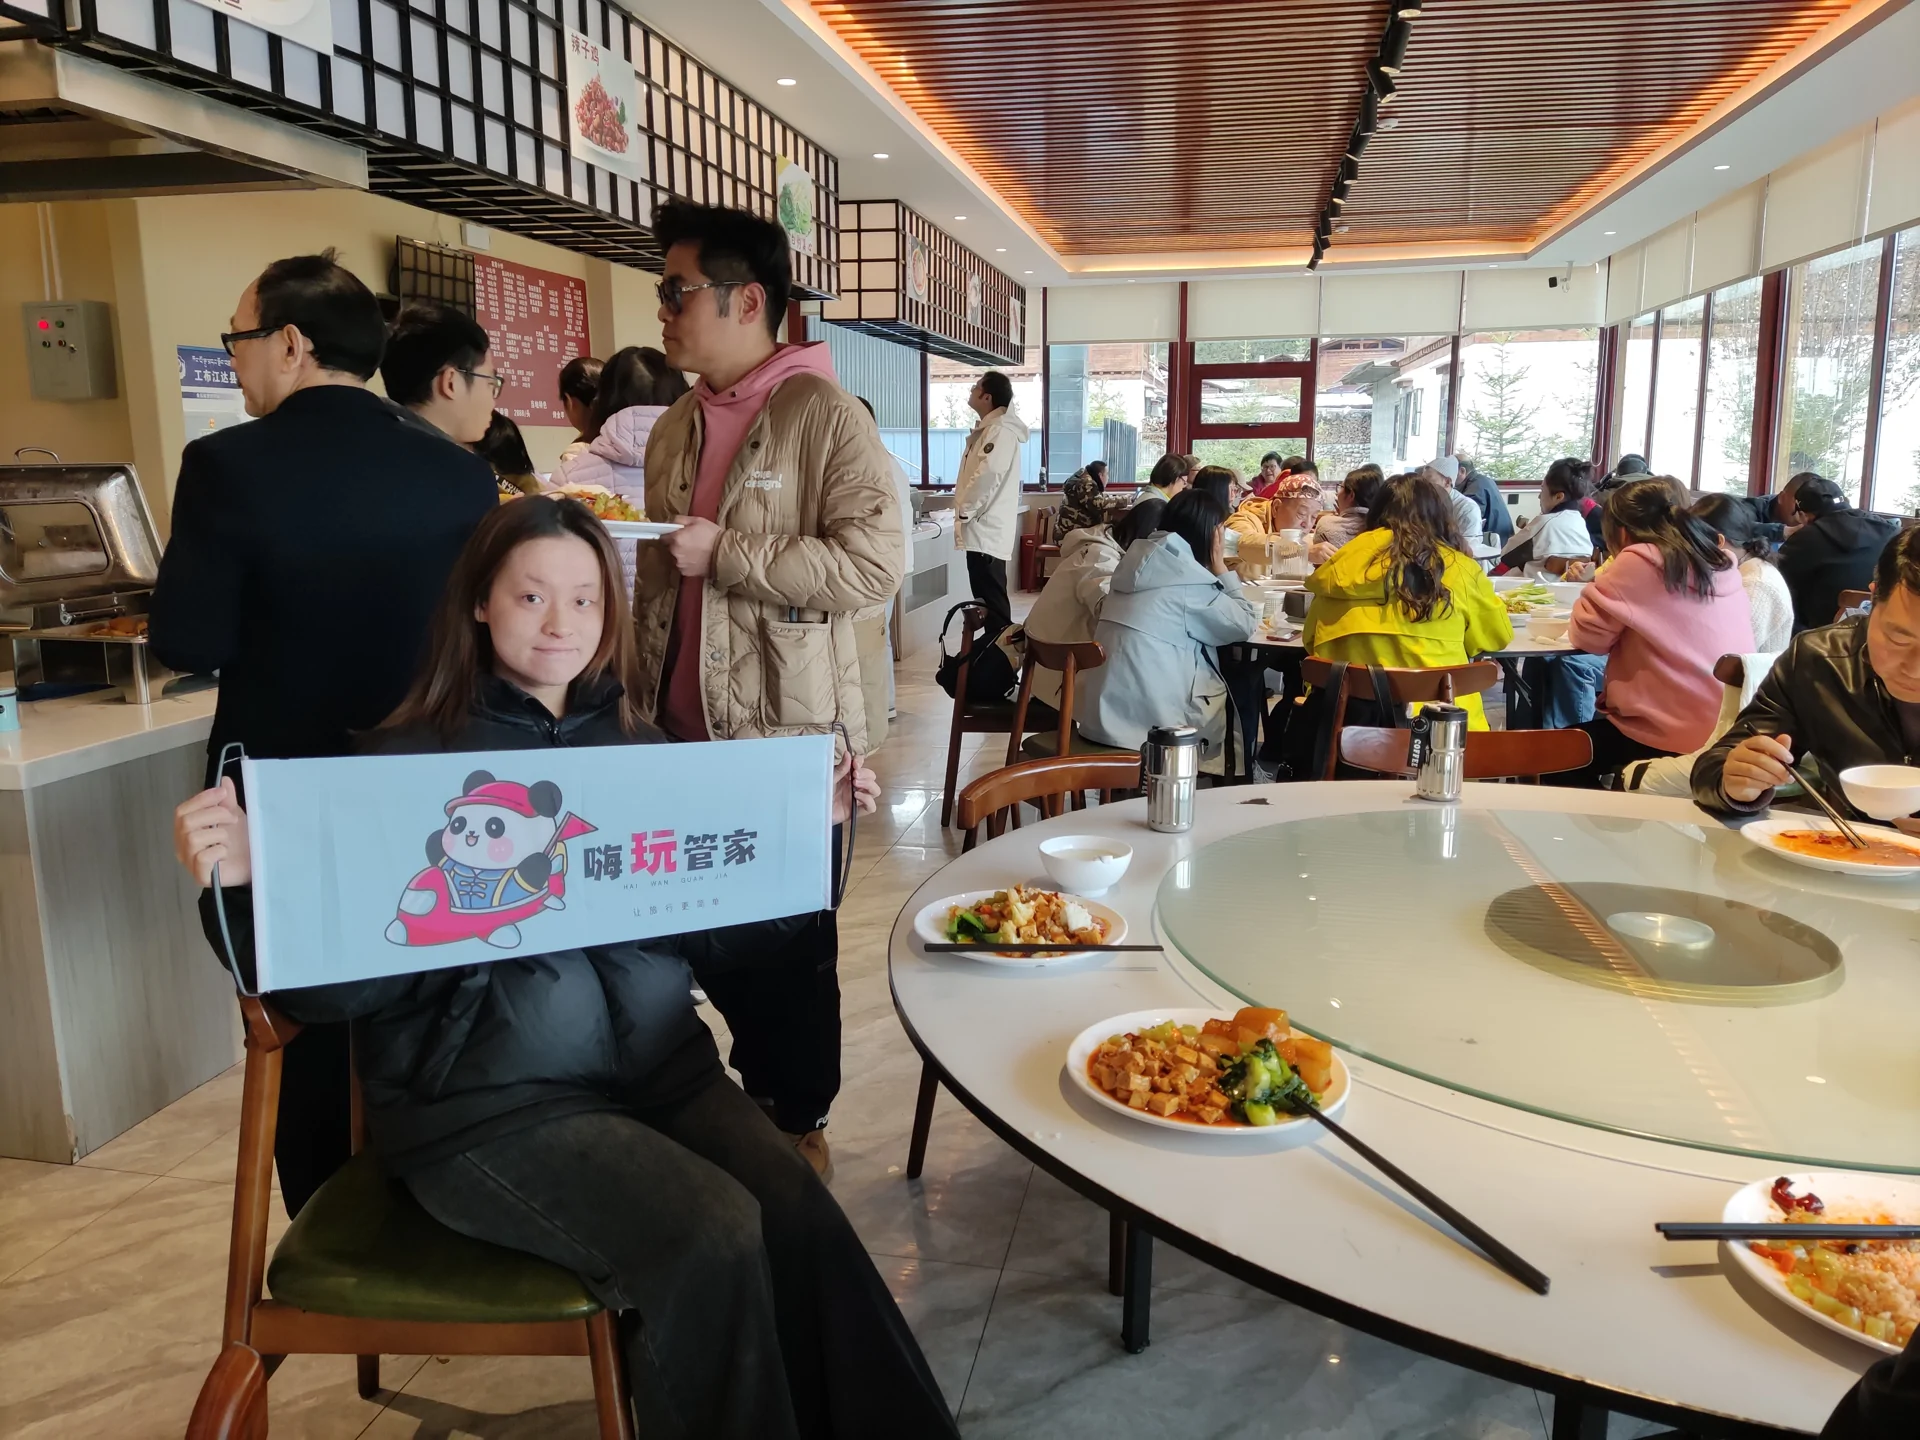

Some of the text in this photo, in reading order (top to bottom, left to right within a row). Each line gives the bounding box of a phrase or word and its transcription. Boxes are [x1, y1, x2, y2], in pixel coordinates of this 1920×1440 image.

[571, 32, 600, 66] 辣子鸡
[194, 369, 238, 385] 工布江达县
[1411, 738, 1422, 768] COFFEE
[583, 828, 758, 882] 嗨玩管家
[650, 879, 669, 887] WAN
[680, 875, 704, 884] GUAN
[714, 872, 728, 880] JIA
[633, 897, 720, 917] 让旅行更简单
